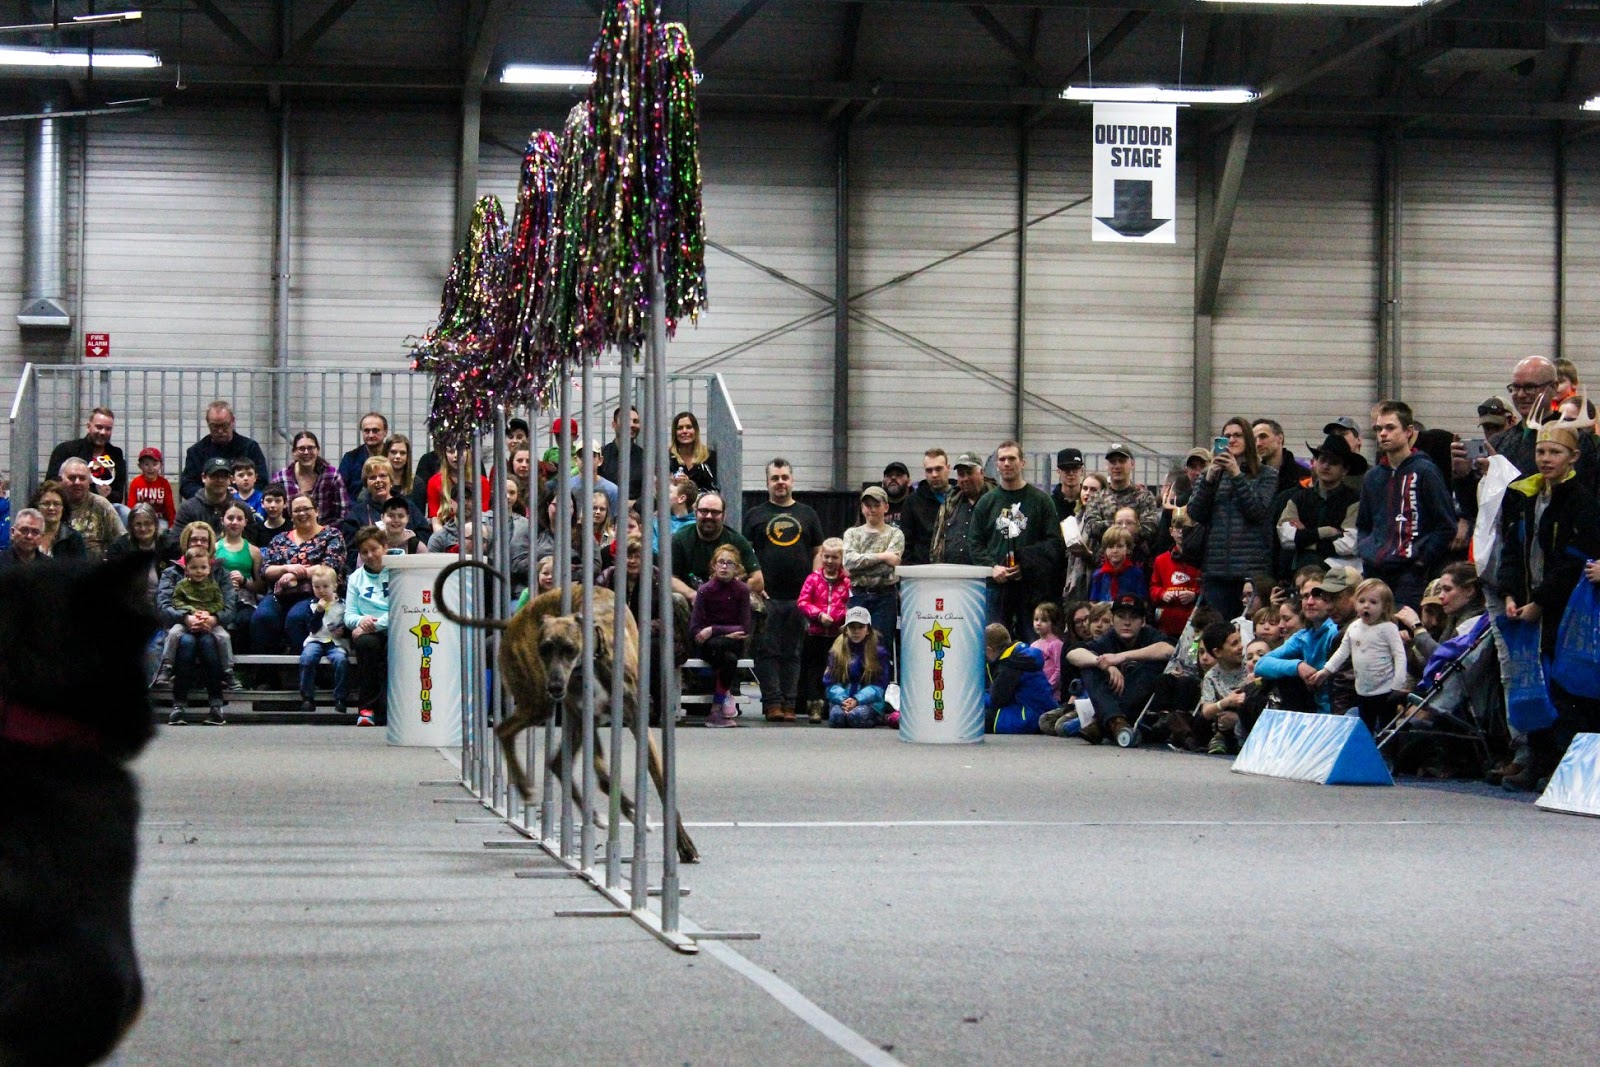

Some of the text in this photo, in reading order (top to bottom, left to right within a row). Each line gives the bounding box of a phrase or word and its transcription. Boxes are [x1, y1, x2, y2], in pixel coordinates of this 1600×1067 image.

[1095, 124, 1172, 146] OUTDOOR
[1111, 147, 1162, 168] STAGE
[136, 487, 165, 500] KING
[420, 624, 433, 723] SUPERDOGS
[933, 629, 945, 721] SUPERDOGS
